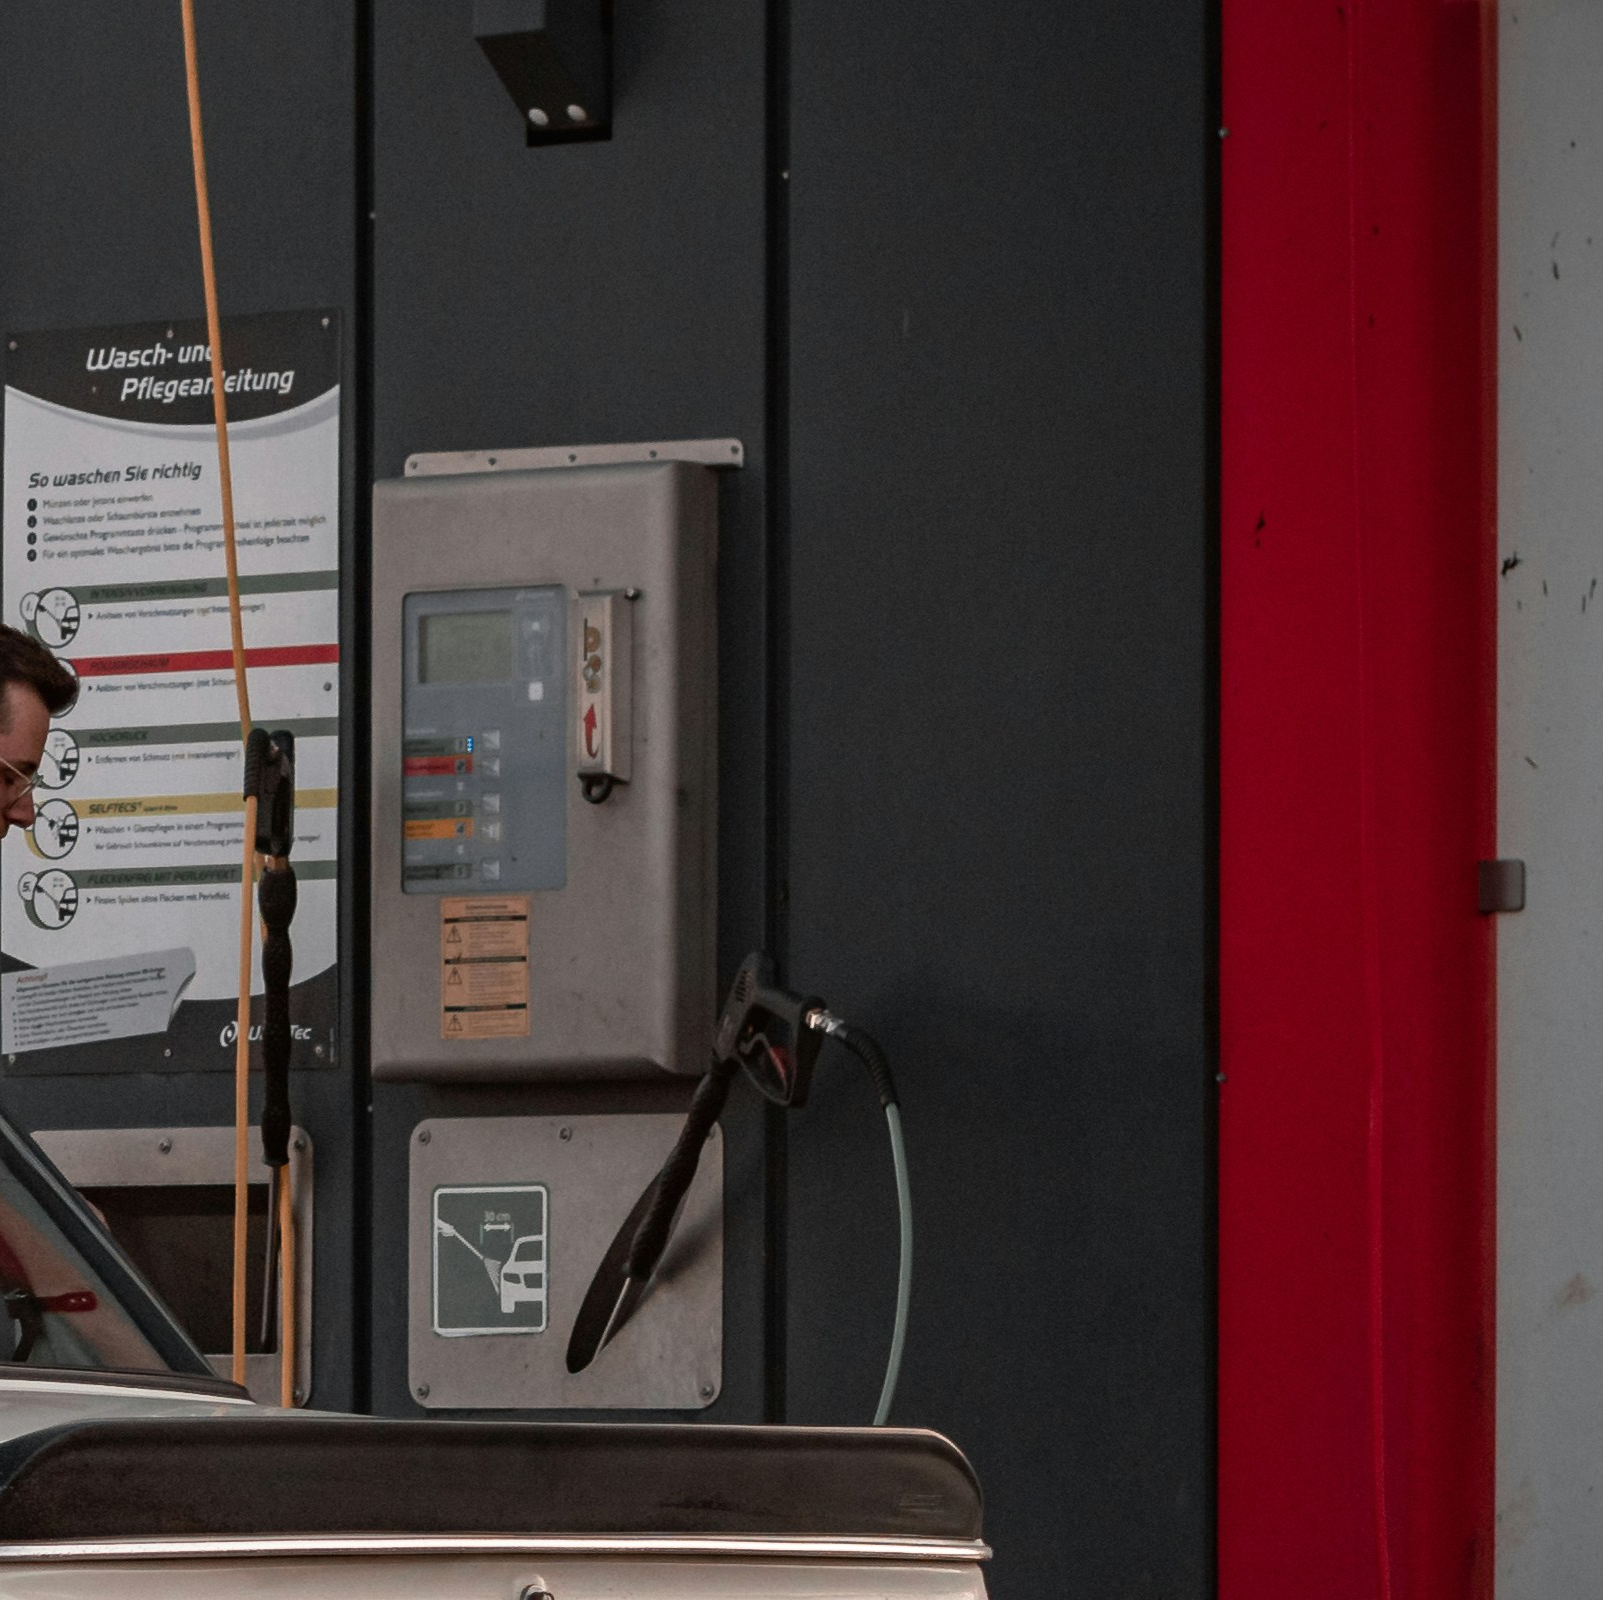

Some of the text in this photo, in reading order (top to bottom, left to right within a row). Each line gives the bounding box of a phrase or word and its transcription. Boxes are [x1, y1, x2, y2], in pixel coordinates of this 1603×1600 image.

[86, 343, 173, 371] Wasch-
[120, 369, 295, 404] Pflegeaneitung
[28, 462, 202, 488] So waschen Sie richtig
